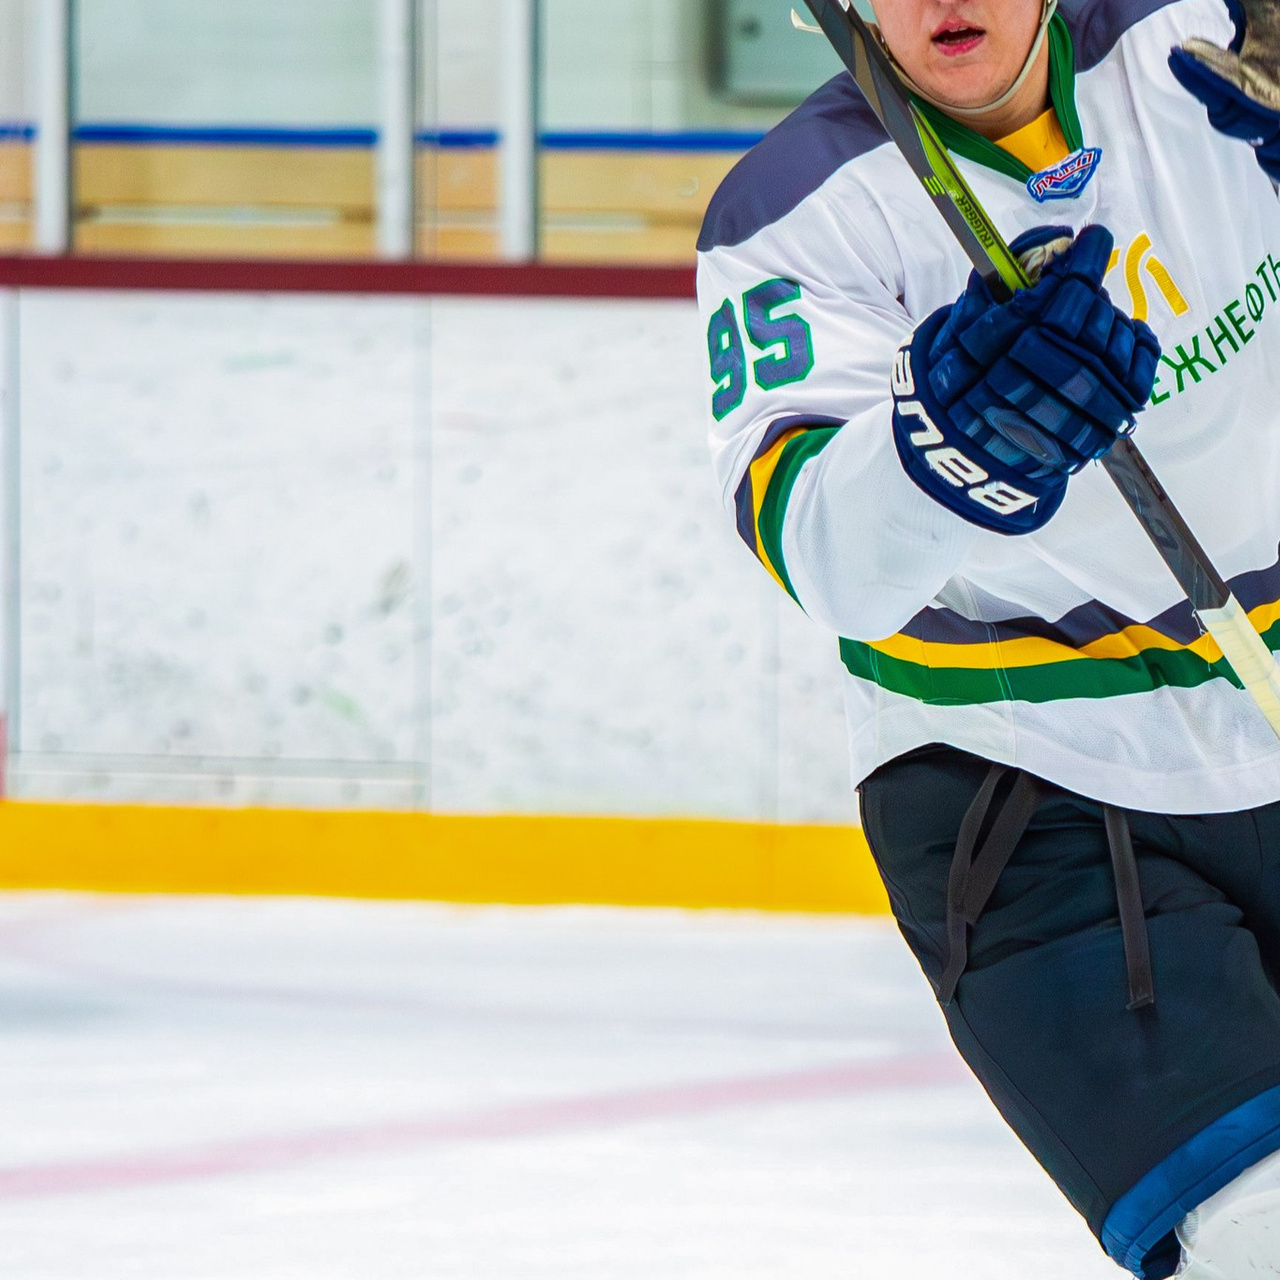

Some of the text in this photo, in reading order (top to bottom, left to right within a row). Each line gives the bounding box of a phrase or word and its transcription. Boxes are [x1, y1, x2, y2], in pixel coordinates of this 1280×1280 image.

[955, 195, 995, 249] TRIGGER
[706, 276, 816, 423] 95
[890, 332, 1041, 516] BAUE
